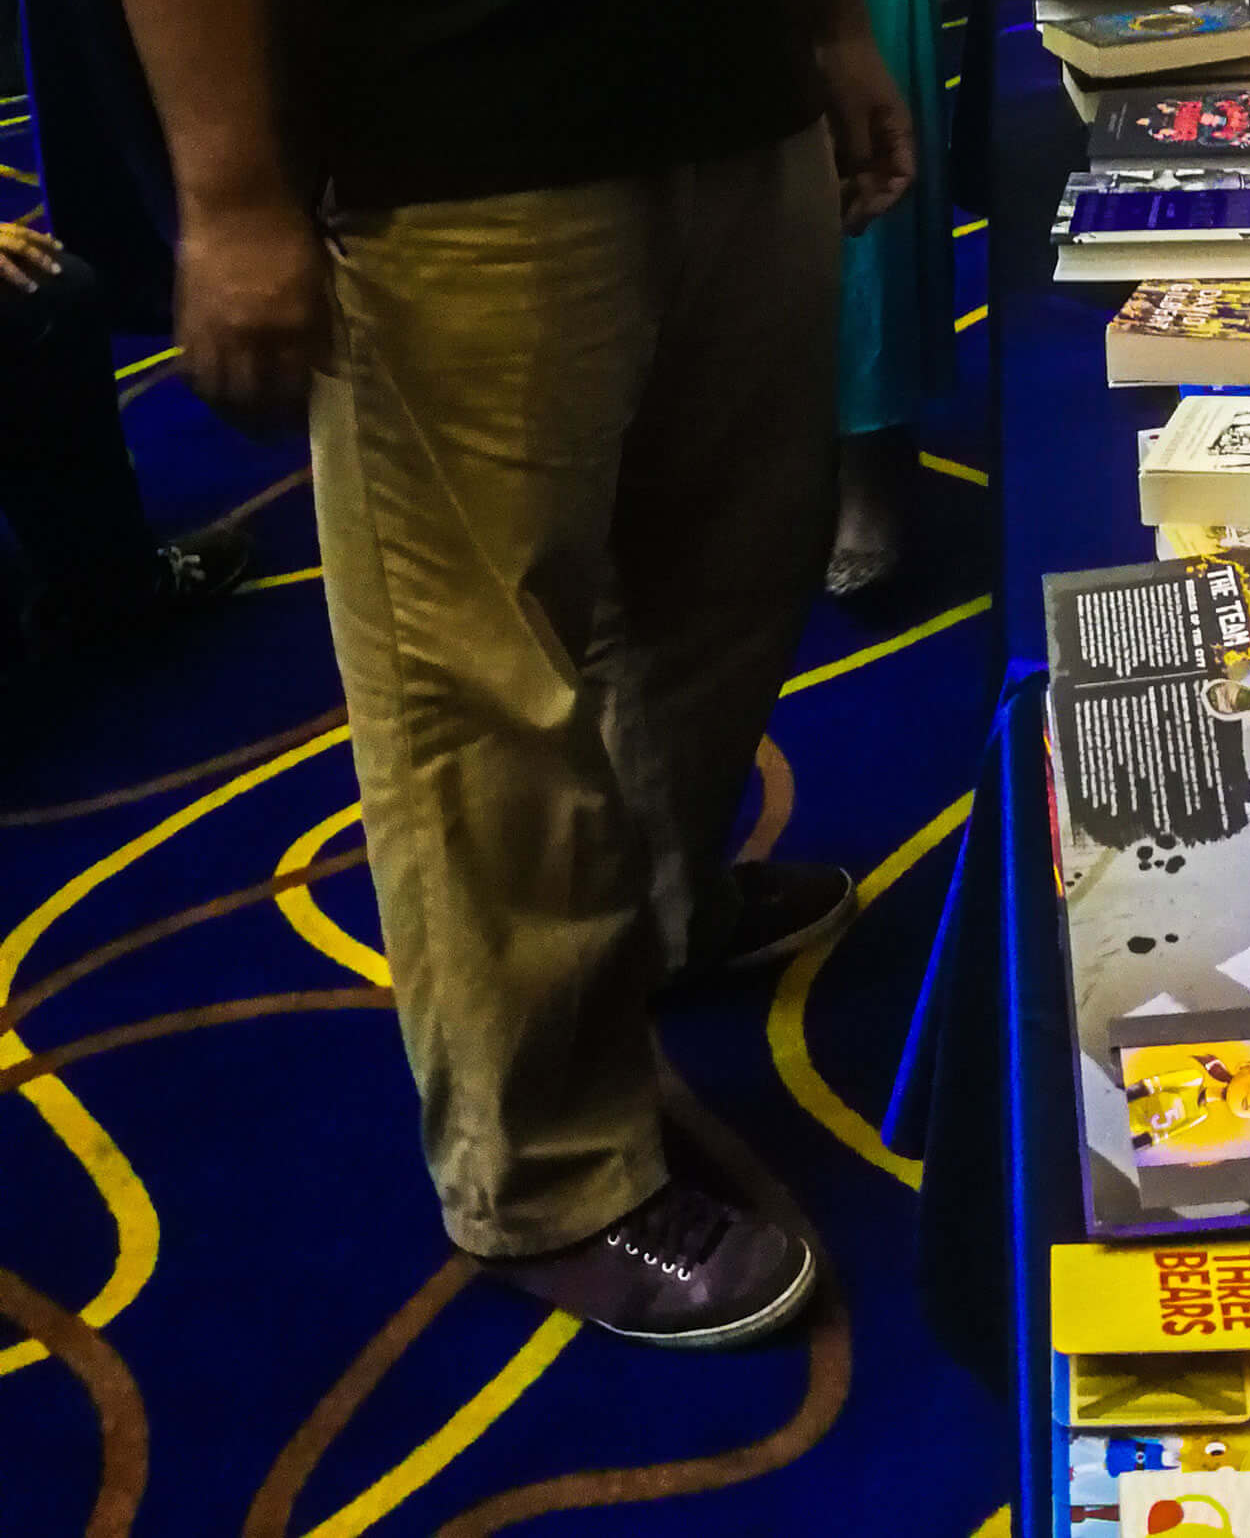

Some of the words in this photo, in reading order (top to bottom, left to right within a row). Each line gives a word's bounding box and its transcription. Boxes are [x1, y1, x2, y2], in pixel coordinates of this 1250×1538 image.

[1182, 289, 1223, 326] DAVID
[1206, 566, 1237, 600] THE
[1213, 596, 1250, 648] TEAM
[1153, 1250, 1217, 1337] BEARS
